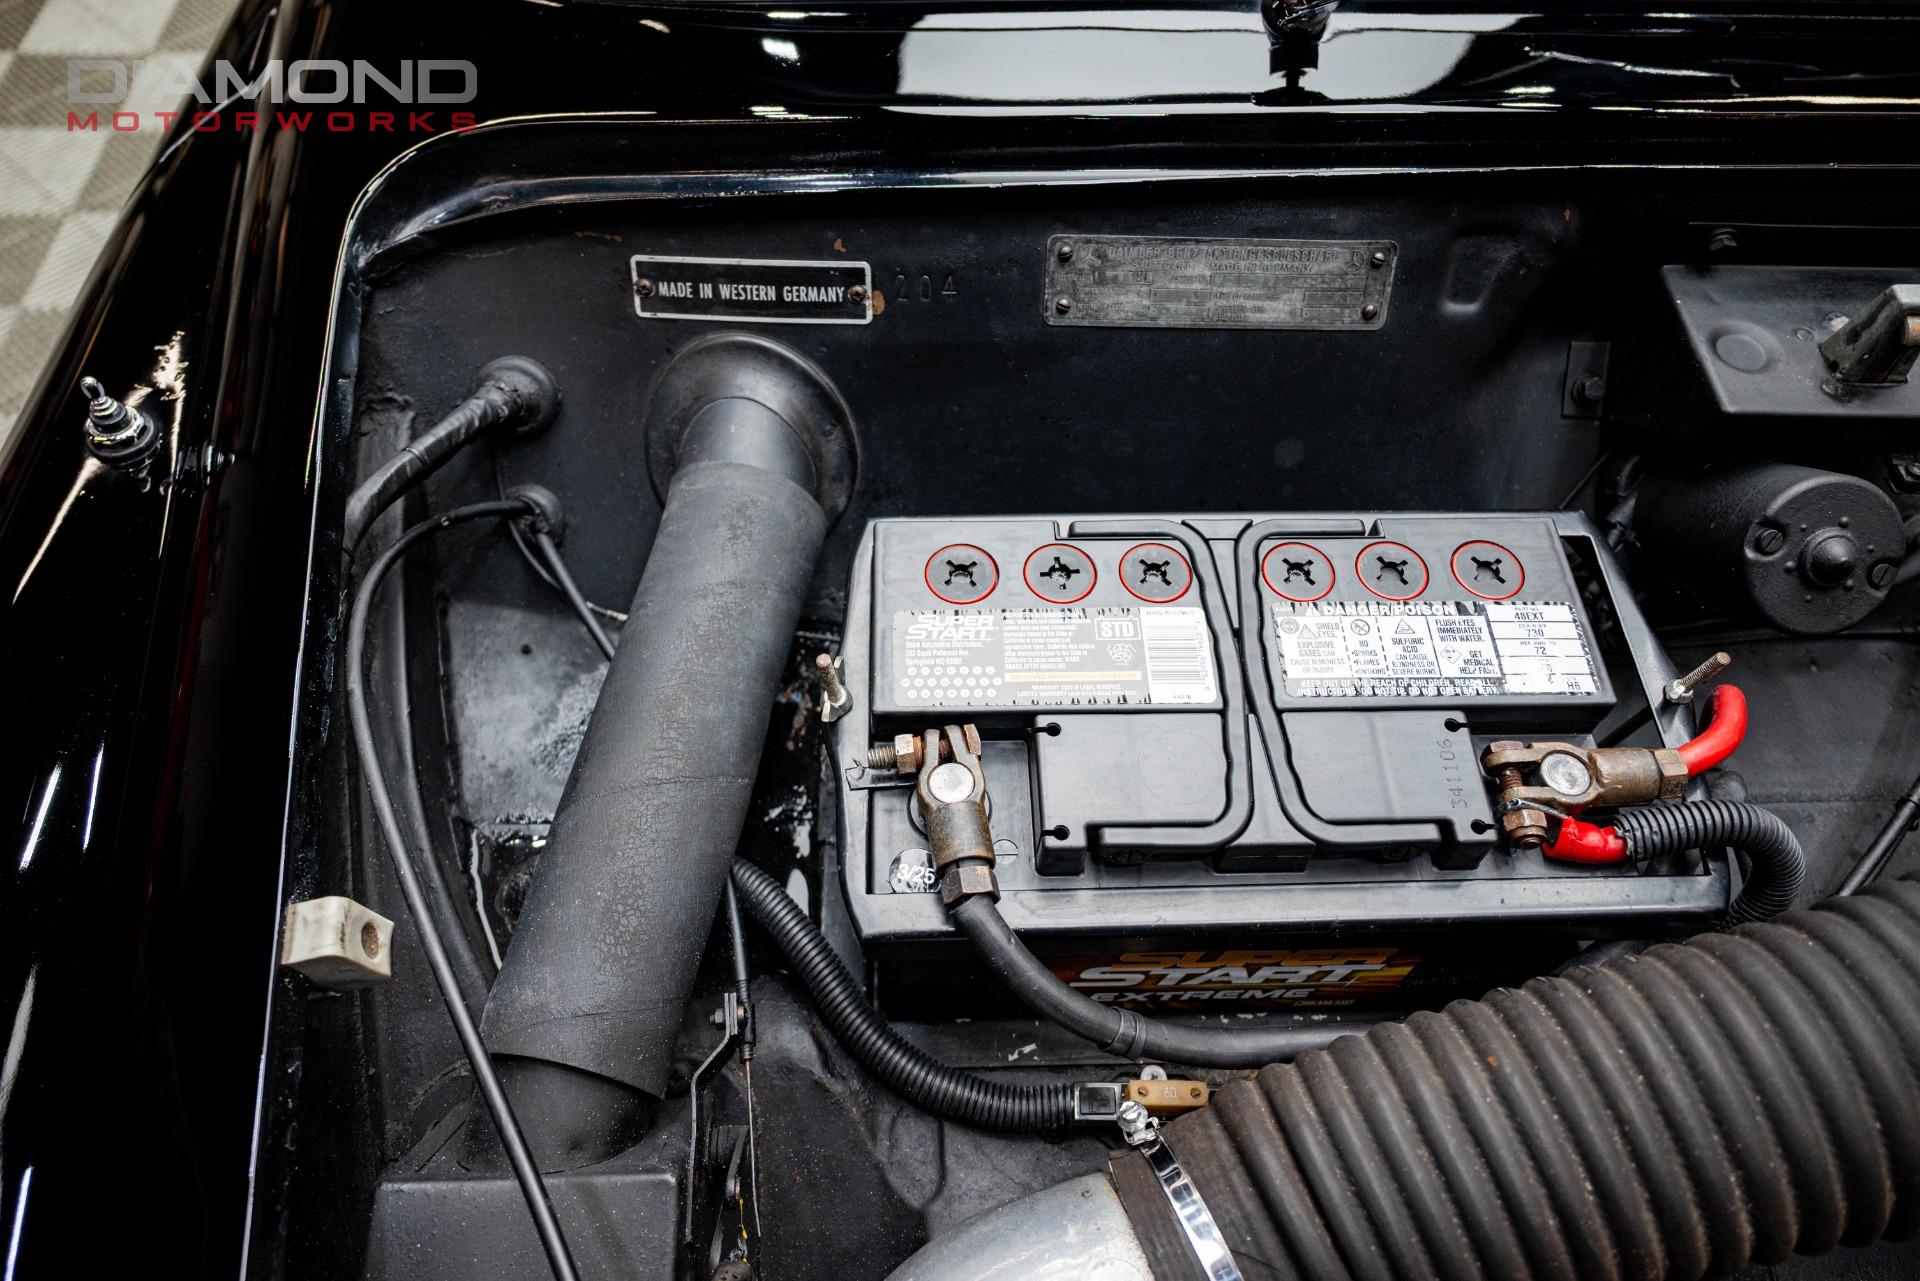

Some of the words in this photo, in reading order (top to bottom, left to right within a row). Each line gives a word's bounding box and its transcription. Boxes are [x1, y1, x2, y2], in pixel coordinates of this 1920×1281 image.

[658, 281, 694, 299] MADE
[699, 282, 713, 299] IN
[718, 283, 777, 301] WESTERN
[783, 285, 845, 303] GERMANY
[917, 615, 994, 626] SUPER
[1514, 612, 1544, 620] 48EXT
[905, 626, 994, 640] START
[1101, 621, 1134, 637] STD
[1525, 628, 1544, 637] 730
[1534, 646, 1547, 655] 72
[1361, 687, 1374, 696] DO
[1375, 687, 1390, 696] NOT
[1409, 687, 1420, 696] DO
[1422, 687, 1437, 696] NOT
[1440, 687, 1462, 696] OPEN
[1436, 738, 1468, 809] 341106
[897, 863, 936, 885] 3/25
[1119, 949, 1399, 967] SUPER
[1069, 964, 1390, 988] START
[1090, 988, 1316, 1003] EXTREME
